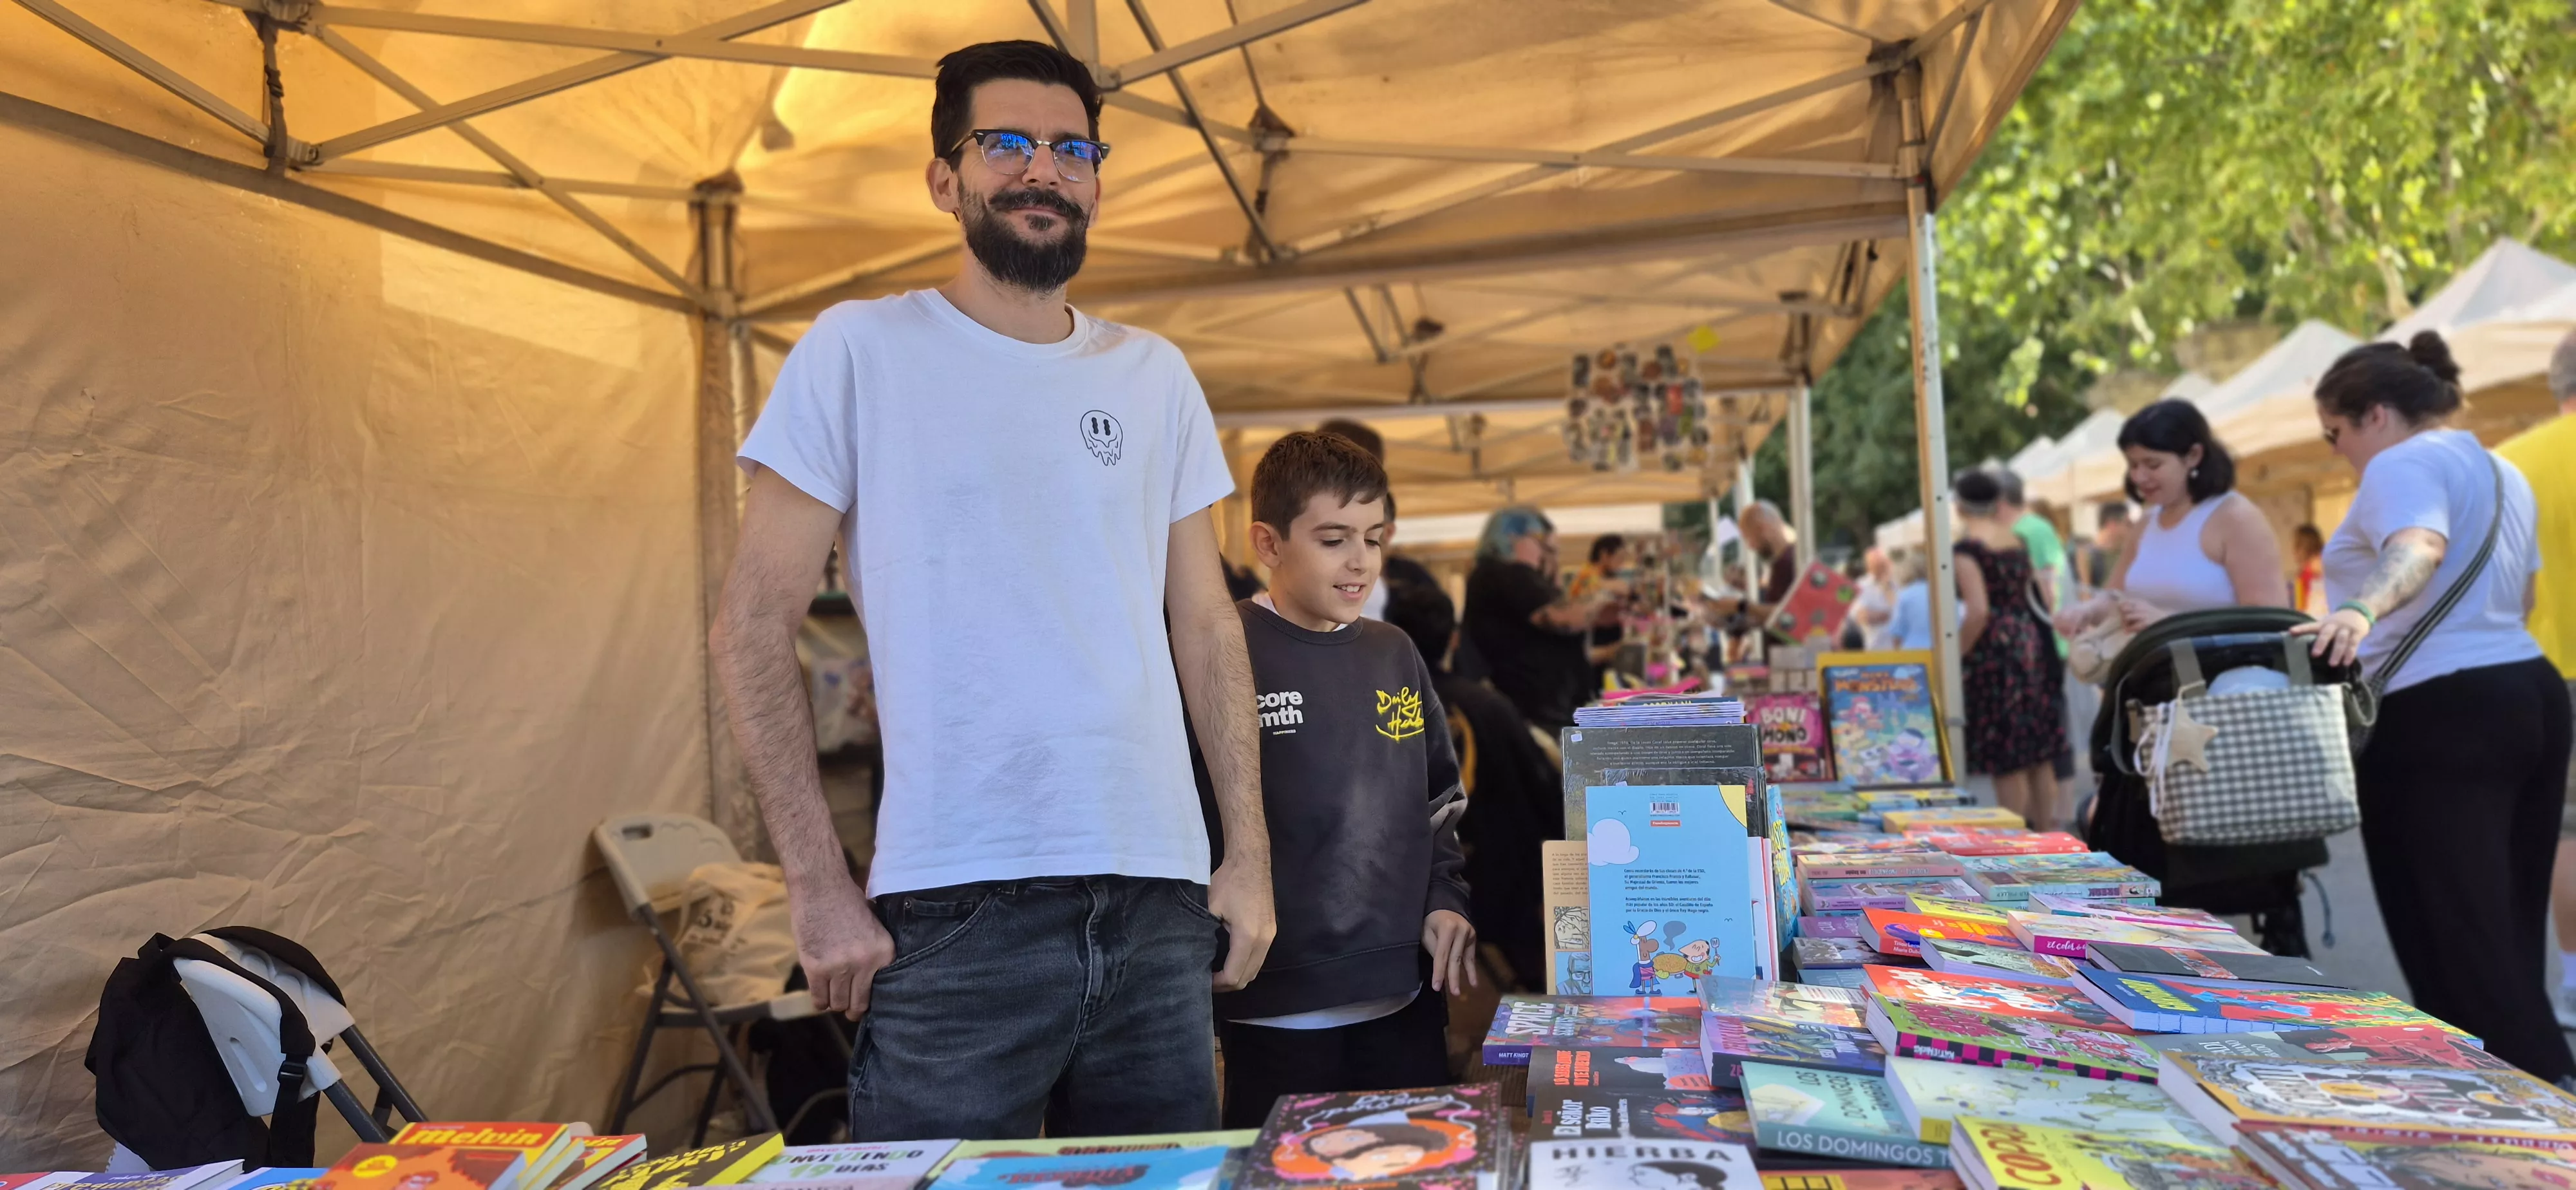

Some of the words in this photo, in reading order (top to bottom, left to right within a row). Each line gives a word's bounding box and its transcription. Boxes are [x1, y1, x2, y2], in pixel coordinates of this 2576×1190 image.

[1505, 1001, 1555, 1035] SPACE
[1552, 1145, 1732, 1162] HIERBA
[1777, 1130, 1813, 1150] LOS
[1819, 1135, 1933, 1165] DOMINGOS
[772, 1149, 924, 1166] ONVIVIENDO
[789, 1164, 835, 1178] 19
